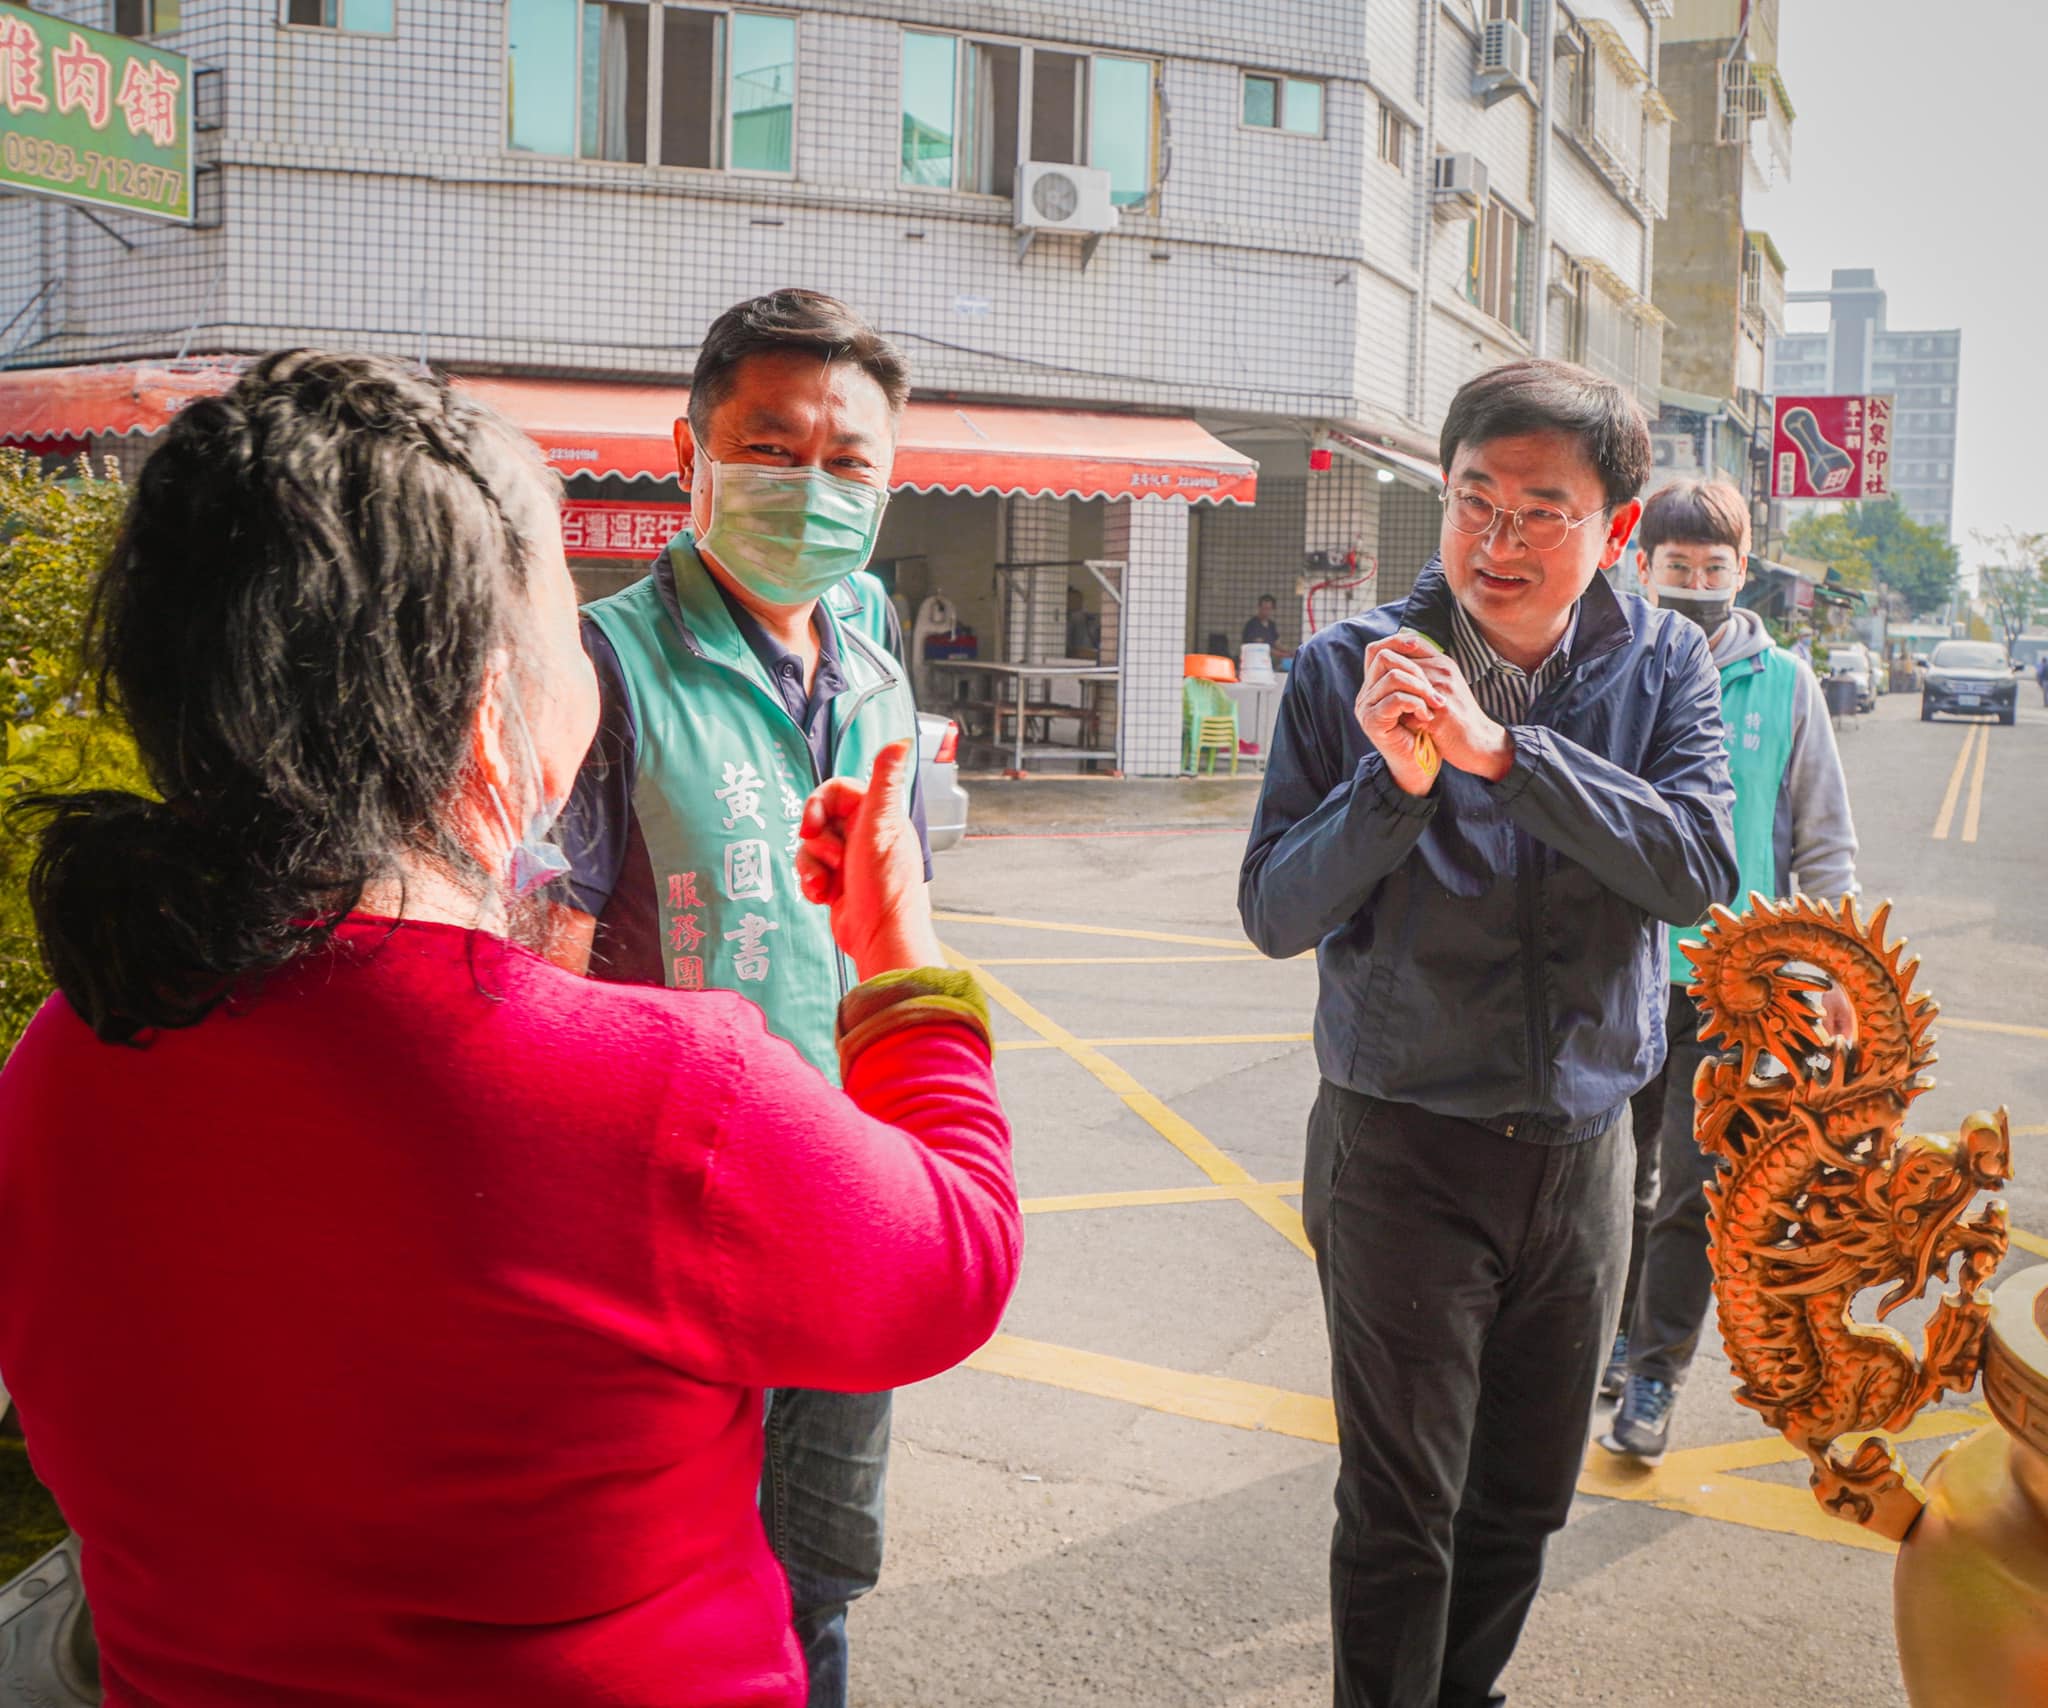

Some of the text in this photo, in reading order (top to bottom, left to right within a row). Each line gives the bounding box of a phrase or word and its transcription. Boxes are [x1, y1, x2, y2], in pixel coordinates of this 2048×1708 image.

[4, 132, 183, 207] 0923-712677
[562, 511, 694, 549] 台灣溫控生
[714, 761, 780, 982] 黃國書
[666, 871, 707, 991] 服務團
